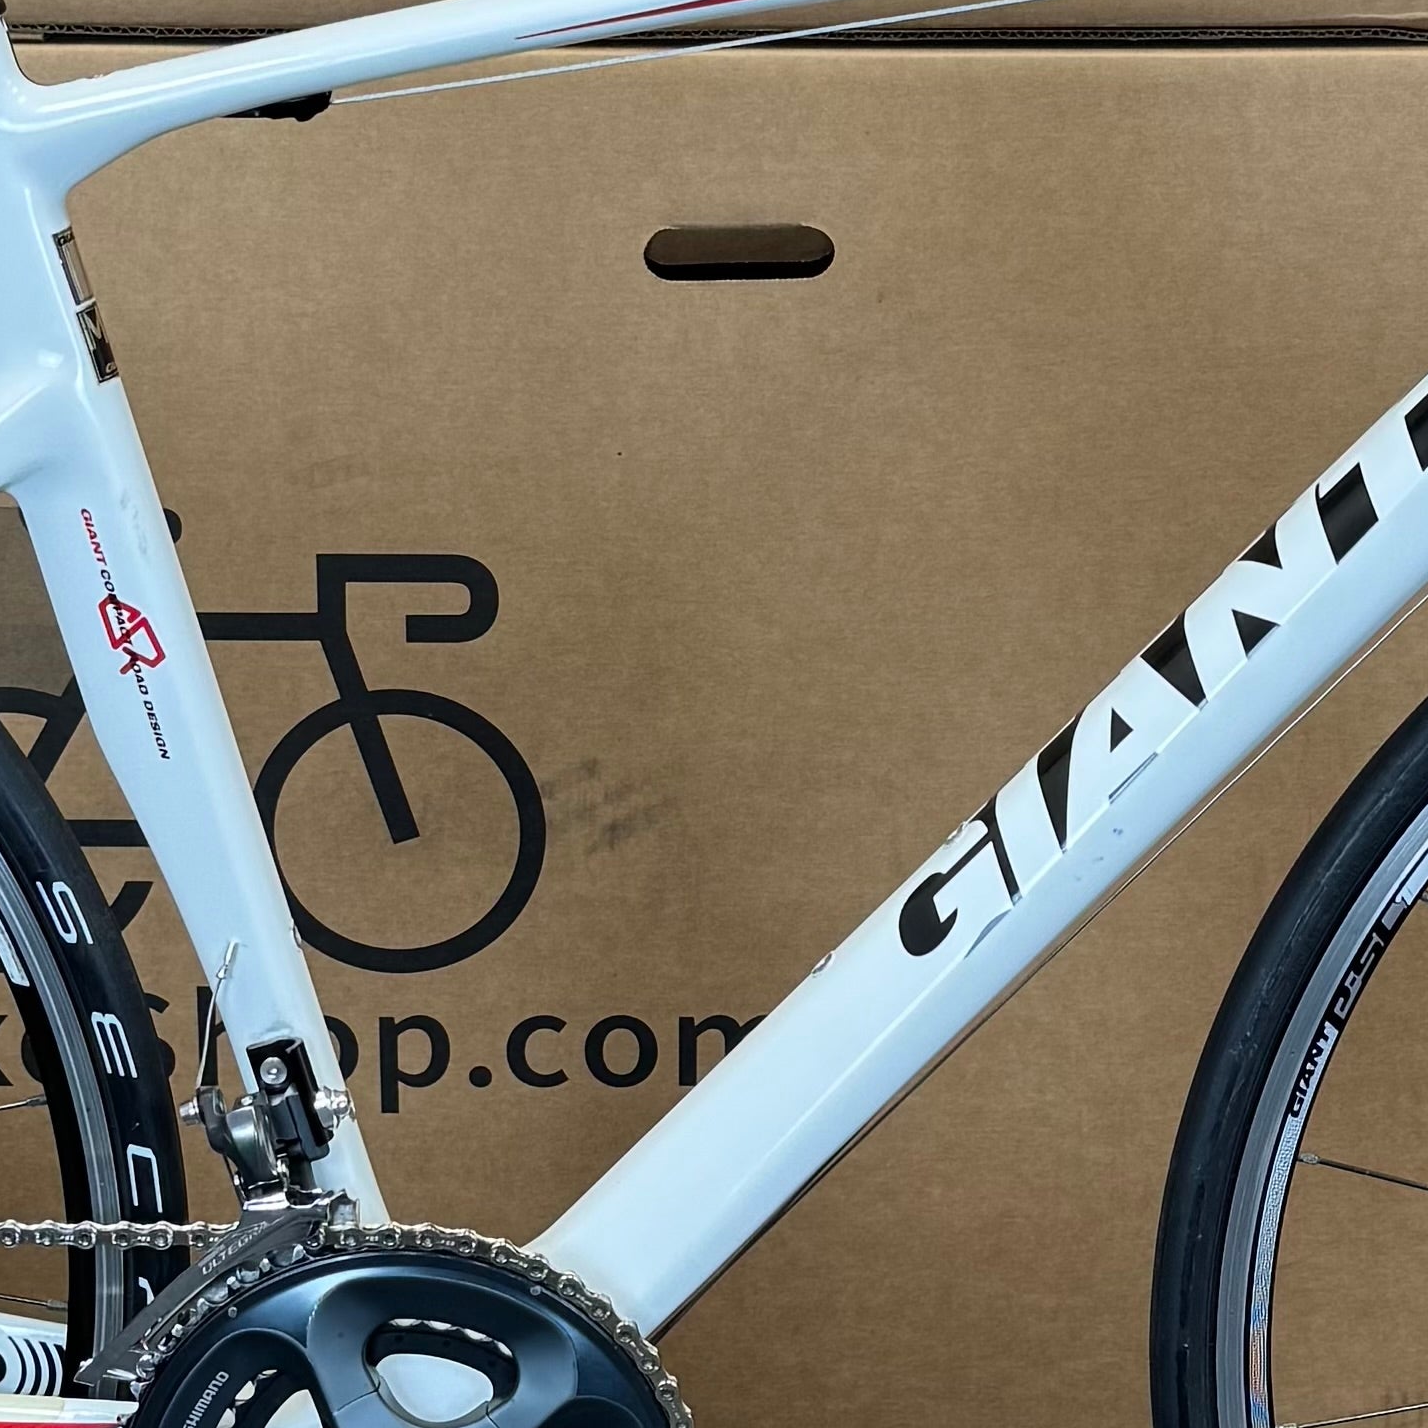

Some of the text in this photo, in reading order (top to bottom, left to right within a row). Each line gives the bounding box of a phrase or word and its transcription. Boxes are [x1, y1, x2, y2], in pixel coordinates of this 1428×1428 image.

[80, 507, 108, 567] GIANT
[143, 698, 172, 760] DESIGN
[1288, 1020, 1339, 1120] GIANT
